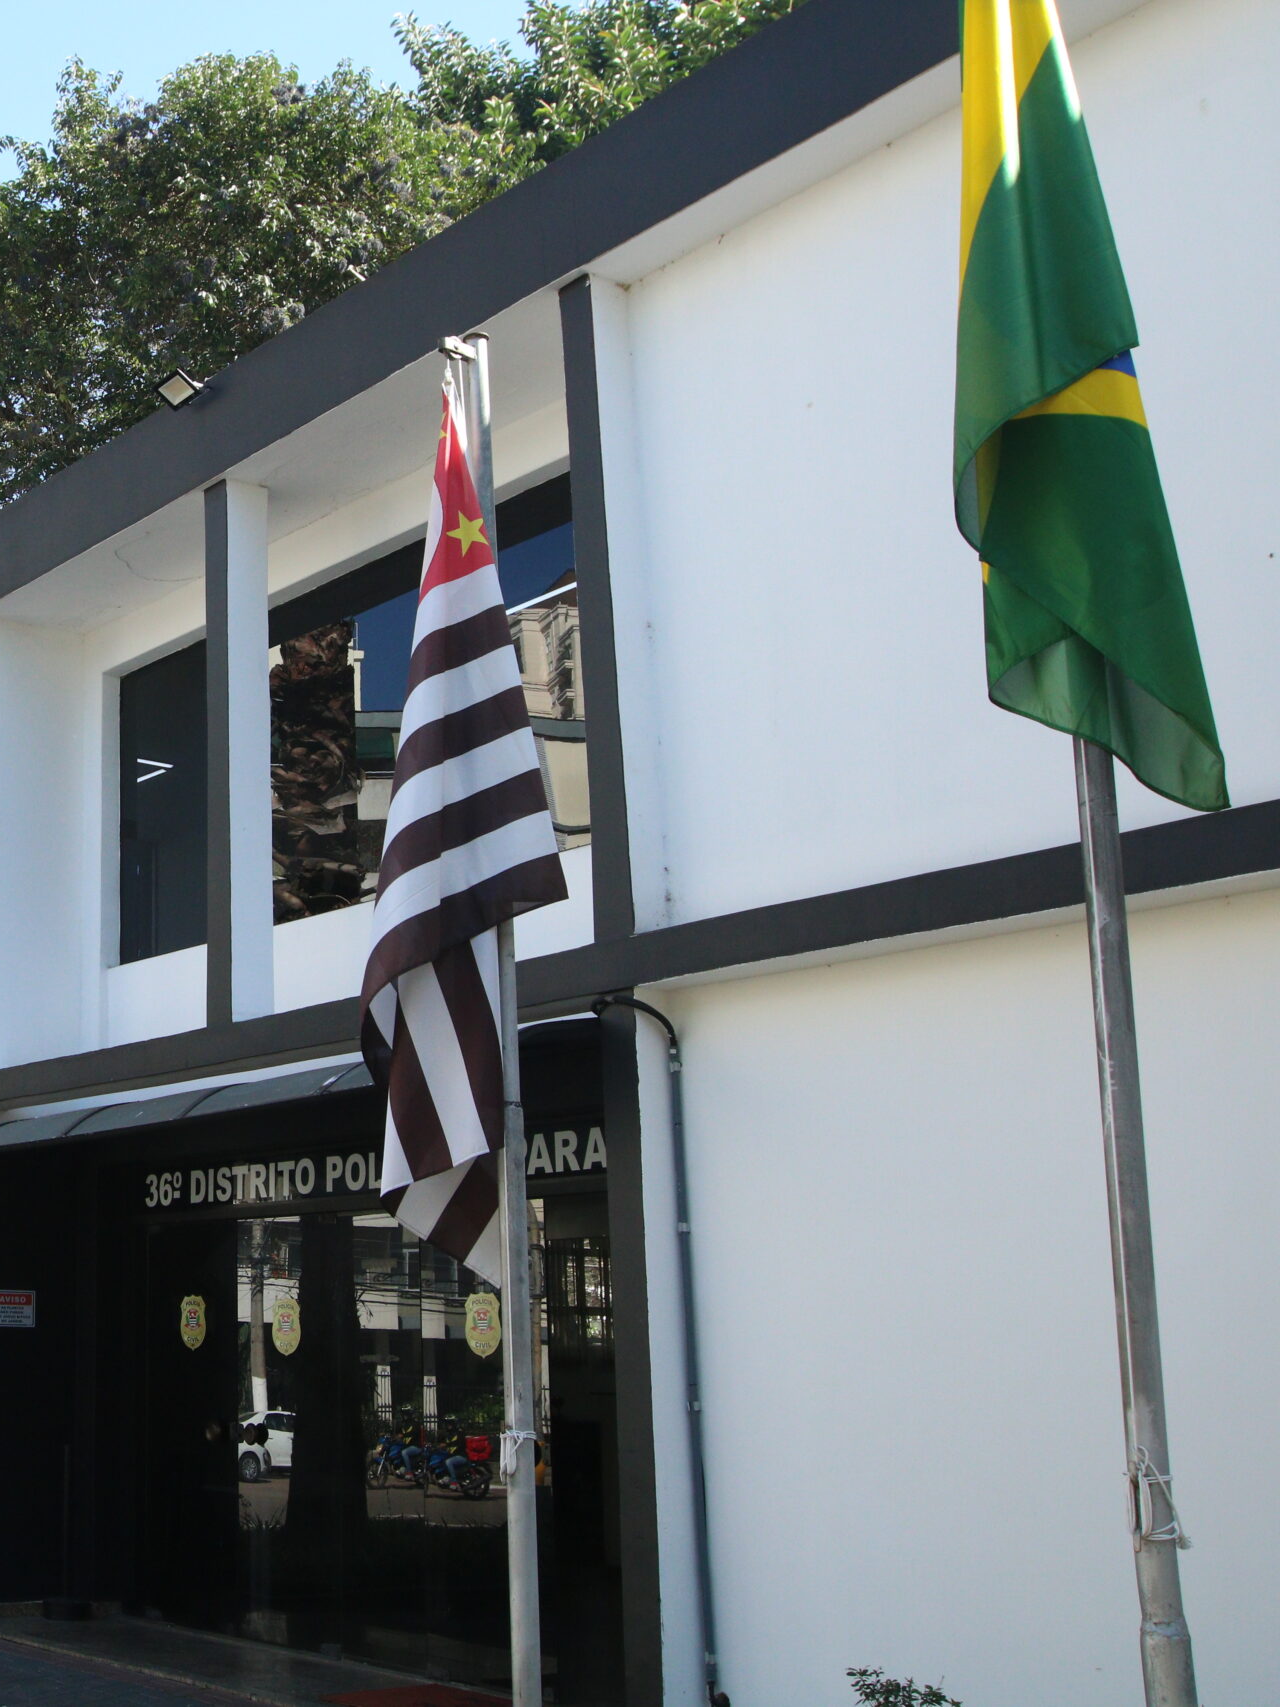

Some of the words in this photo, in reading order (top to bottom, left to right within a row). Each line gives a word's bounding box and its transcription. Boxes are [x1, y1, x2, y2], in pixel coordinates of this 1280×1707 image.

[190, 1158, 315, 1204] DISTRITO
[326, 1152, 382, 1193] POL
[524, 1126, 607, 1175] ARA
[474, 1341, 491, 1349] CIVIL
